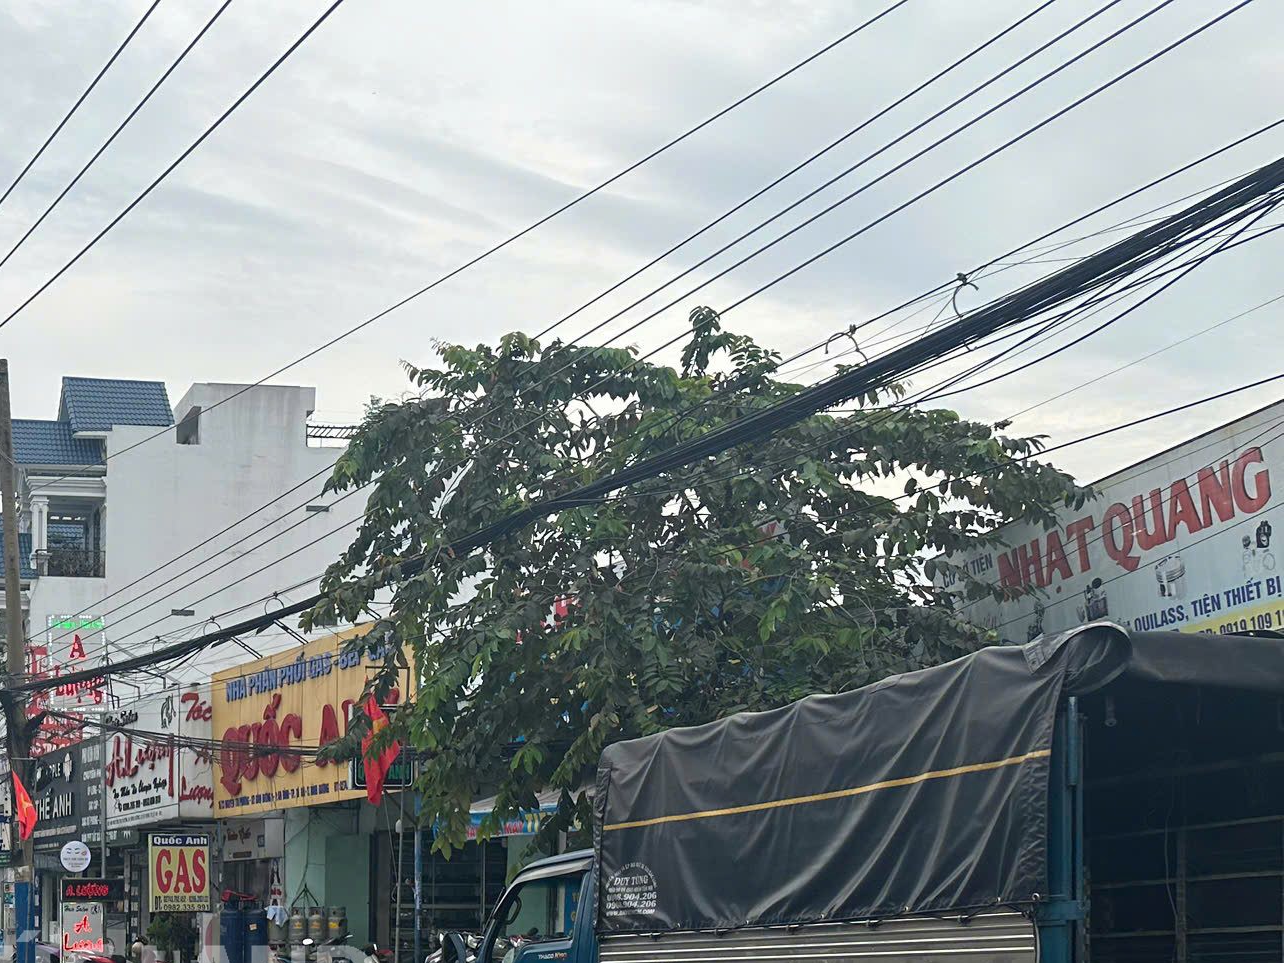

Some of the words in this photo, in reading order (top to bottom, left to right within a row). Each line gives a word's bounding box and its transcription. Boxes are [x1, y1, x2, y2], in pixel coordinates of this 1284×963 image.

[1103, 446, 1272, 572] QUANG
[1191, 594, 1222, 618] TIỆN
[1223, 577, 1262, 607] THIẾT
[1266, 575, 1282, 598] BỊ
[1250, 613, 1273, 631] 109
[308, 652, 333, 680] GAS
[220, 692, 303, 796] QUỐC
[52, 792, 72, 819] ANH
[153, 834, 183, 846] Quốc
[185, 835, 208, 846] Anh
[156, 848, 206, 894] GAS
